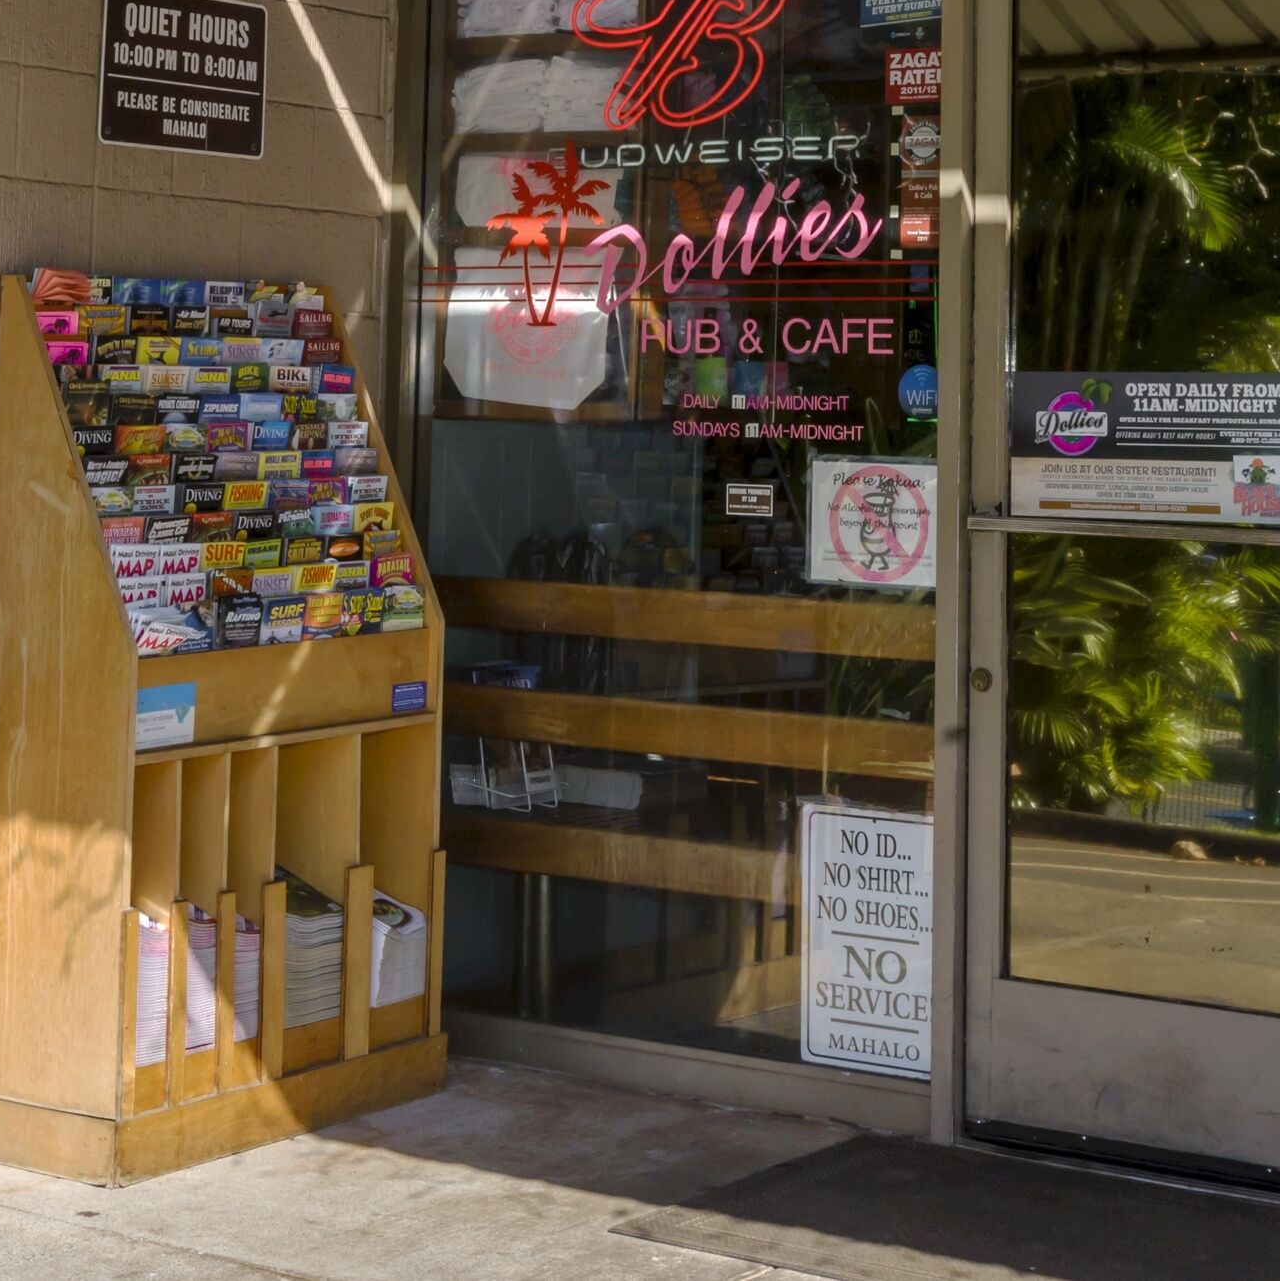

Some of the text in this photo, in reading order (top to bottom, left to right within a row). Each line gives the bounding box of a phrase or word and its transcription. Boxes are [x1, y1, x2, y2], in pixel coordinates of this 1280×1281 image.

[872, 4, 902, 15] EVERY
[125, 3, 249, 48] QUIET HOURS
[182, 52, 199, 74] TO
[901, 86, 937, 95] 2011/12
[117, 91, 249, 122] PLEASE BE CONSIDERATE
[163, 119, 206, 139] MAHALO
[584, 177, 883, 314] Dollies
[299, 314, 333, 323] SAILING
[641, 318, 894, 355] PUB & CAFE
[307, 342, 341, 352] SAILING
[151, 373, 185, 385] SUNSET
[277, 369, 308, 381] BIKE
[1125, 382, 1171, 398] OPEN
[1176, 383, 1230, 398] DAILY
[202, 404, 238, 413] ZIPLINES
[683, 394, 720, 409] DAILY
[1133, 398, 1277, 414] 11AM-MIDNIGHT
[673, 421, 740, 438] SUNDAYS
[1035, 409, 1107, 444] Dollies
[1041, 464, 1217, 478] JOIN US AT OUR SISTER RESTAURANT!
[229, 483, 264, 500] FISHING
[206, 544, 244, 562] SURF
[161, 557, 199, 574] MAP
[300, 565, 335, 585] FISHING
[170, 586, 204, 606] MAP
[271, 604, 305, 618] SURF
[841, 829, 912, 860] NO ID...
[824, 862, 929, 897] NO SHIRT...
[817, 894, 848, 922] NO
[842, 944, 908, 985] NO
[816, 981, 929, 1022] SERVICE
[828, 1032, 920, 1062] MAHALO
